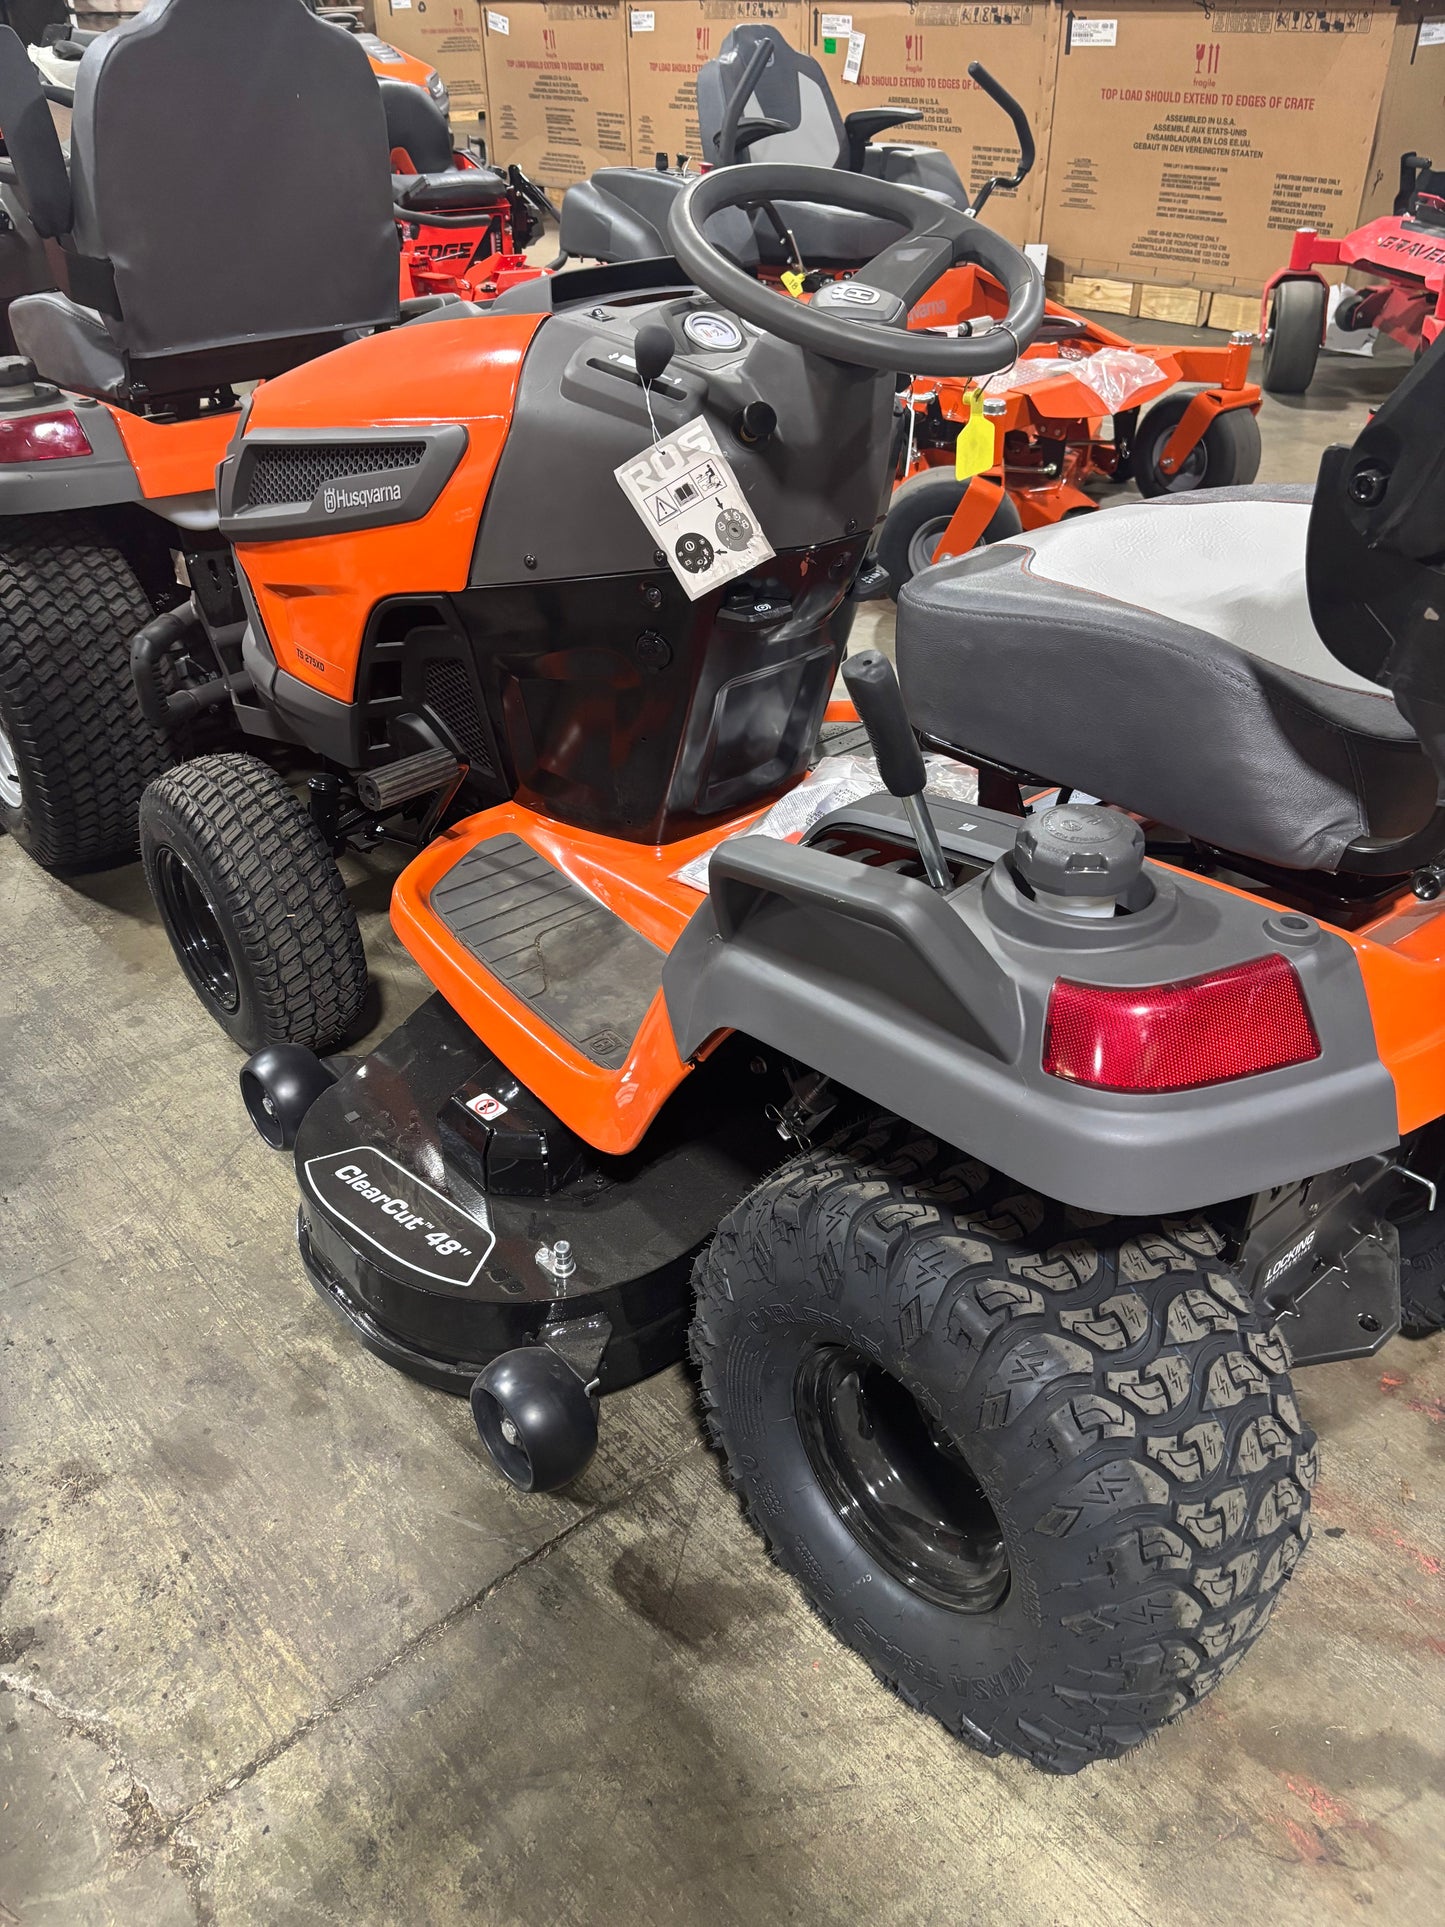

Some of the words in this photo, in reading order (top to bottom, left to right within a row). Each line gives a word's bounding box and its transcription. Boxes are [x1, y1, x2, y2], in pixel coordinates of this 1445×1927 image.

[872, 76, 898, 87] SHOULD
[900, 77, 924, 88] EXTEND
[927, 78, 937, 89] TO
[938, 78, 960, 90] EDGES
[962, 79, 972, 90] OF
[1193, 78, 1216, 89] fragile
[1101, 88, 1118, 100] TOP
[1120, 89, 1143, 101] LOAD
[1145, 90, 1181, 103] SHOULD
[1183, 92, 1219, 105] EXTEND
[1221, 94, 1233, 106] TO
[1236, 95, 1266, 108] EDGES
[1269, 96, 1282, 109] OF
[1284, 97, 1316, 111] CRATE
[1165, 114, 1207, 124] ASSEMBLED
[1208, 116, 1215, 125] IN
[1216, 117, 1236, 126] U.S.A.
[1153, 122, 1190, 133] ASSEMBLÉ
[1191, 126, 1206, 134] AUX
[1207, 126, 1247, 137] ETATS-UNIS
[1146, 133, 1201, 144] ENSAMBLADURA
[1203, 136, 1213, 145] EN
[1213, 137, 1228, 146] LOS
[1133, 142, 1160, 151] GEBAUT
[1161, 143, 1169, 152] IN
[1169, 144, 1184, 153] DEN
[1185, 145, 1230, 157] VEREINIGTEN
[1230, 148, 1263, 159] STAATEN
[414, 242, 474, 261] EDGE
[620, 424, 712, 493] ROS
[337, 484, 401, 509] Husqvarna
[296, 647, 304, 660] TS
[425, 1232, 473, 1257] 48"
[1266, 1230, 1316, 1281] LOCKING
